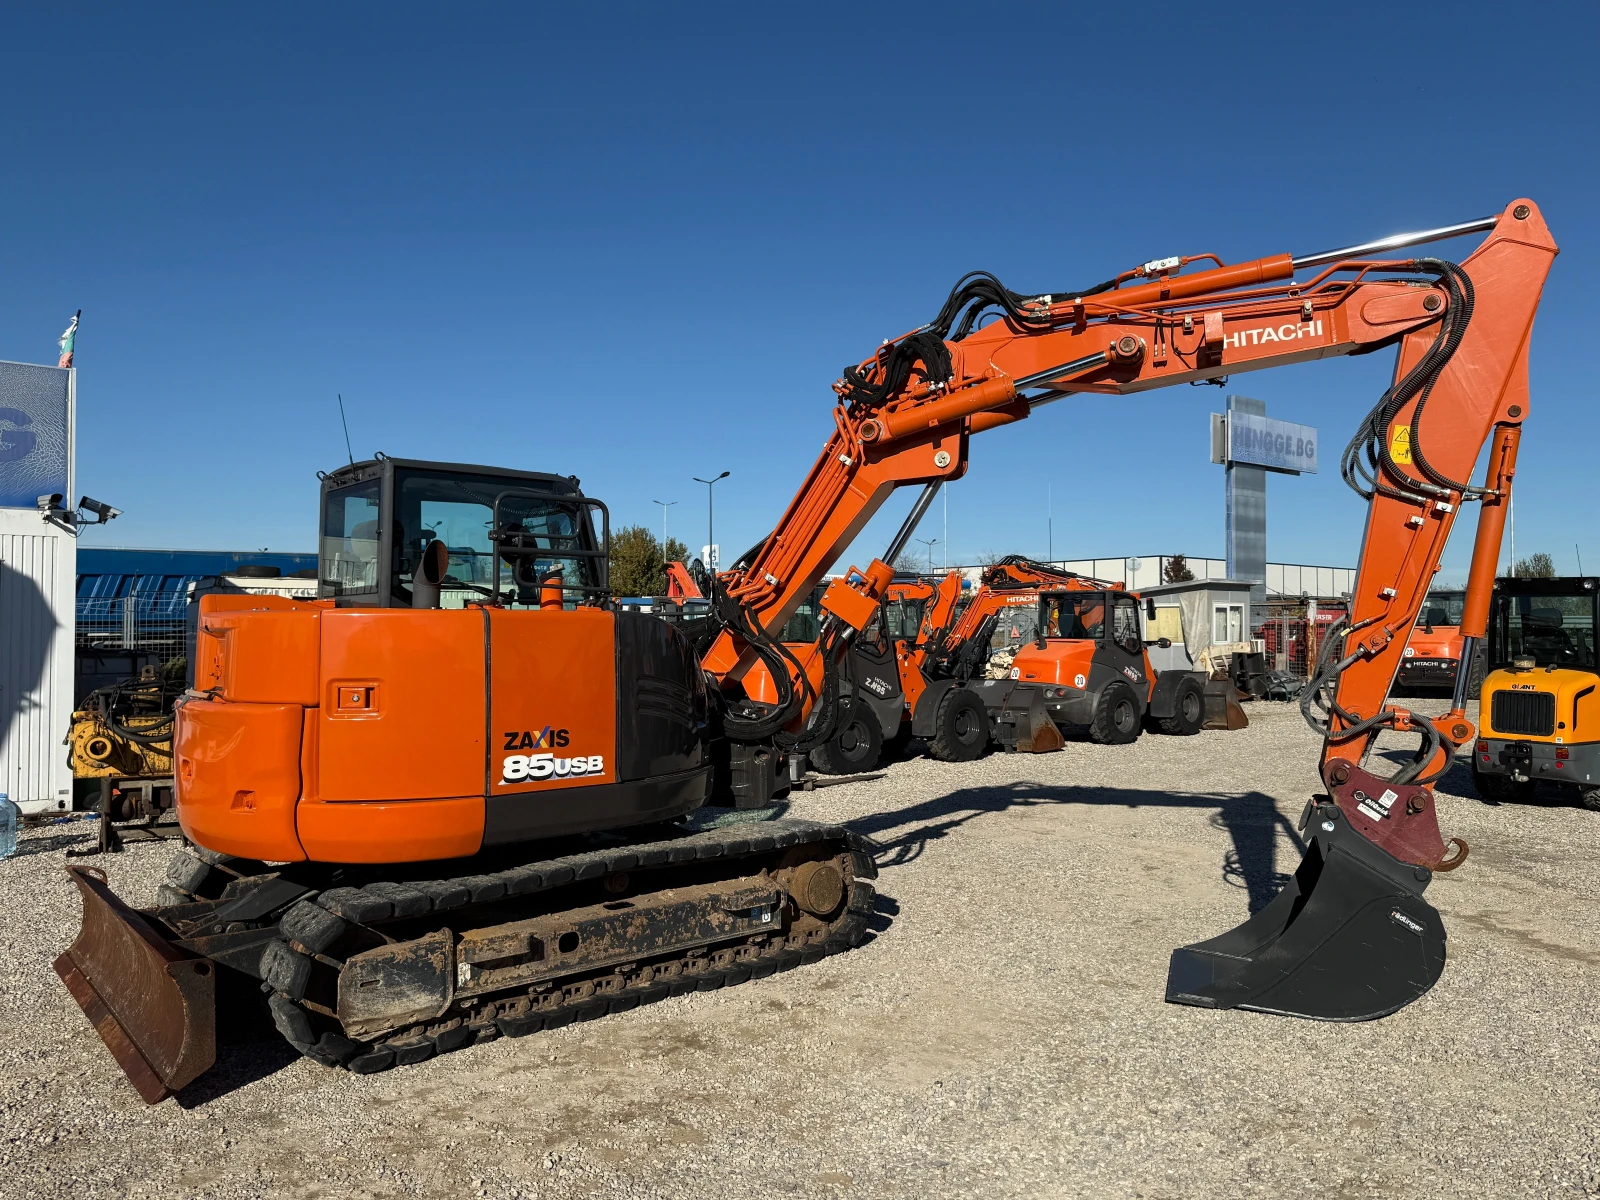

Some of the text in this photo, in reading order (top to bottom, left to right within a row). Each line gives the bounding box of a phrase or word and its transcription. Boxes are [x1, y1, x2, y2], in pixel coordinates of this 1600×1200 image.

[1223, 320, 1322, 349] HITACHI
[1006, 595, 1039, 603] HITACHI
[1076, 676, 1084, 685] 20
[503, 725, 570, 751] ZAXIS
